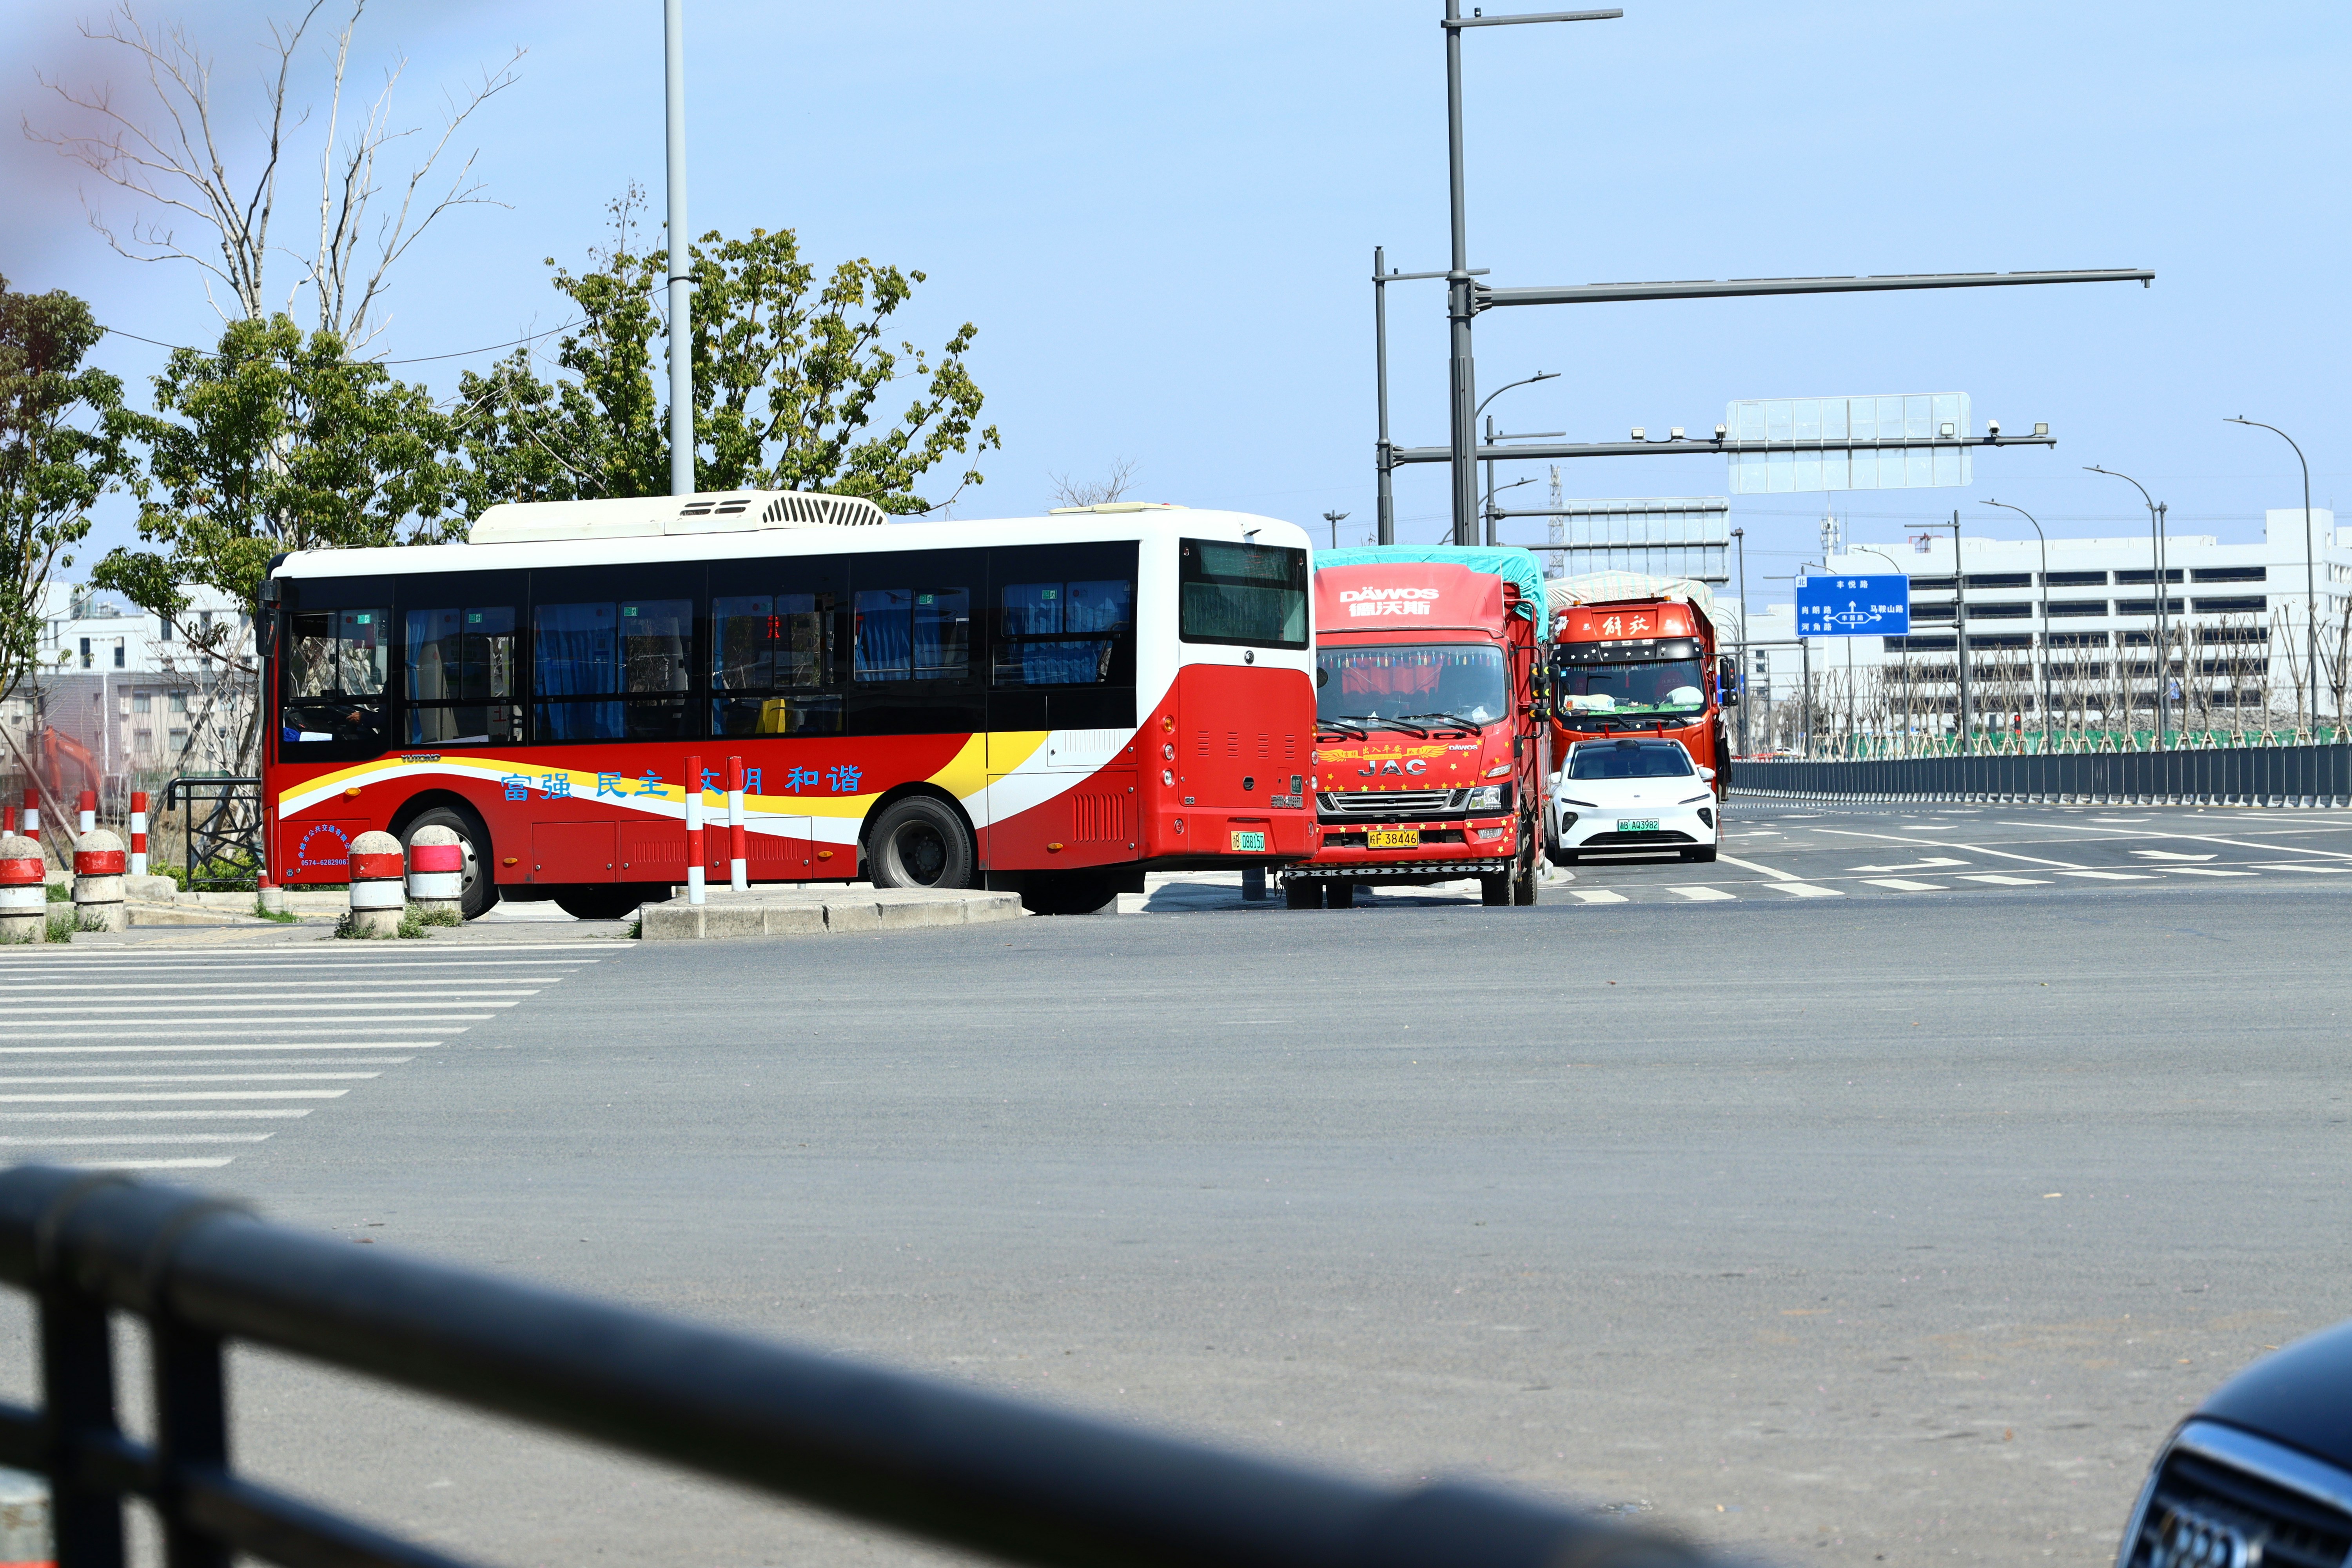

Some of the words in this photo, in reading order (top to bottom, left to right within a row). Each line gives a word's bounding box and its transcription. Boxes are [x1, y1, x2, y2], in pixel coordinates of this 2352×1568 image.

[1837, 580, 1868, 589] 丰悦路
[1340, 586, 1439, 602] DÄWOS
[1348, 601, 1430, 617] 德沃斯
[1802, 606, 1831, 615] 肖朗路
[1870, 604, 1904, 613] 马鞍山路
[1802, 622, 1832, 631] 河角路
[1363, 744, 1402, 754] 出入平安
[401, 754, 441, 763] YUTONG
[1357, 759, 1427, 777] JAC
[501, 773, 573, 801] 富强
[596, 769, 669, 798] 民主
[784, 764, 862, 793] 和谐
[298, 824, 351, 859] 余姚市公共交通有限公
